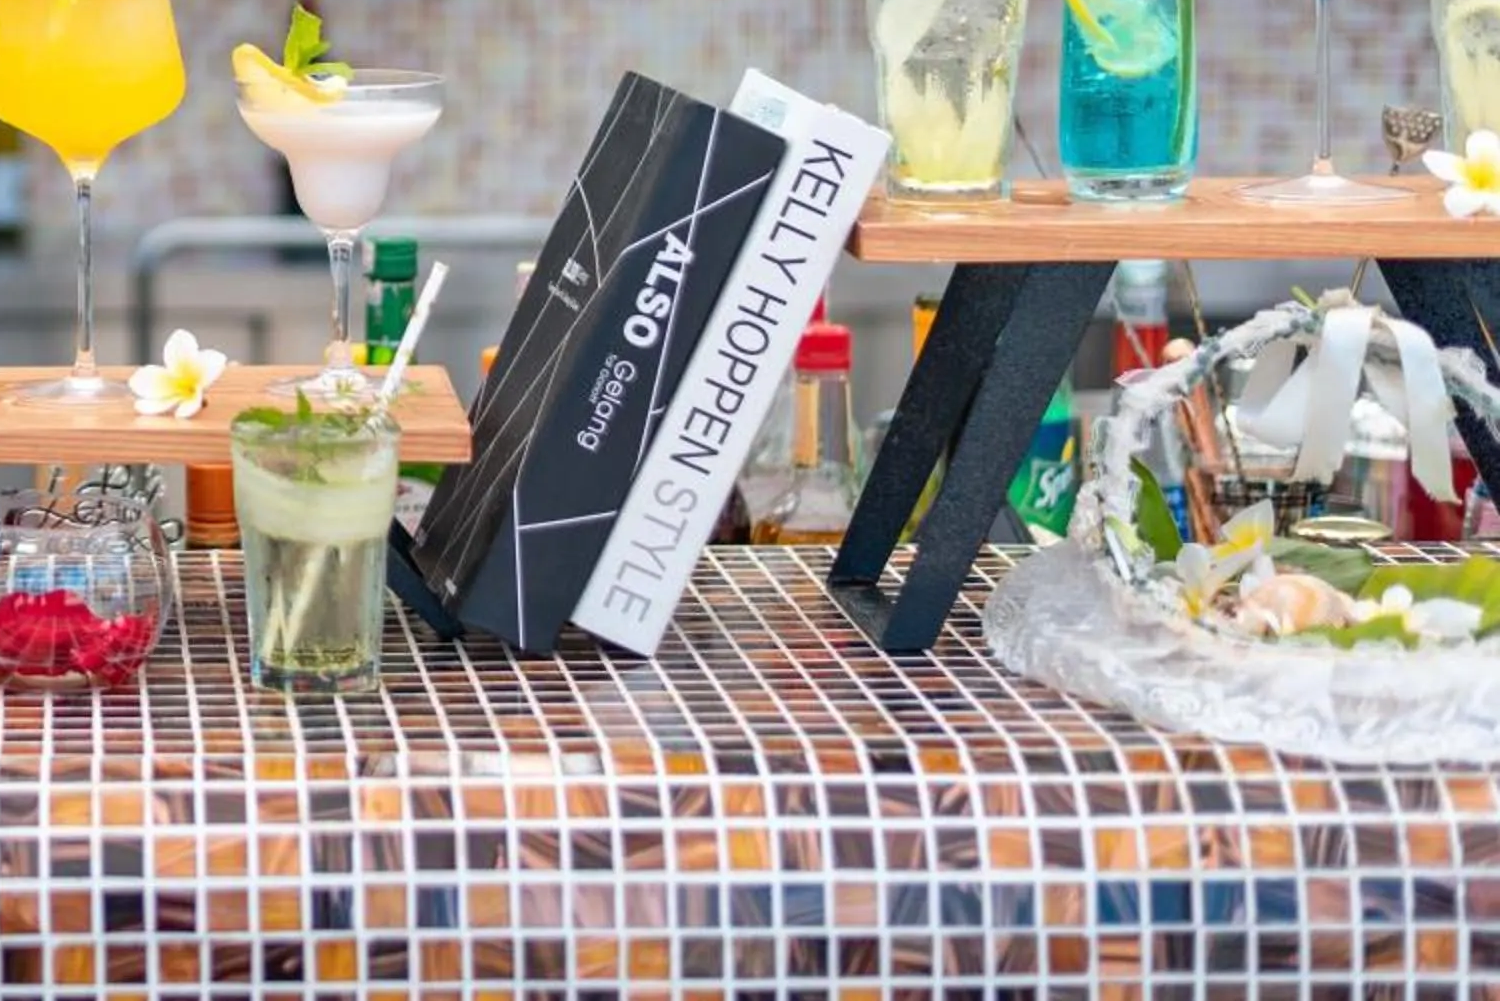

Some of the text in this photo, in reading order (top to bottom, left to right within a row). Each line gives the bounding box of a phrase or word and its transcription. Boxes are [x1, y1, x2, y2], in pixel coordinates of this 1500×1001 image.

[623, 231, 694, 348] ALSO
[577, 360, 636, 452] Gelang
[602, 139, 853, 624] KELLY HOPPEN STYLE
